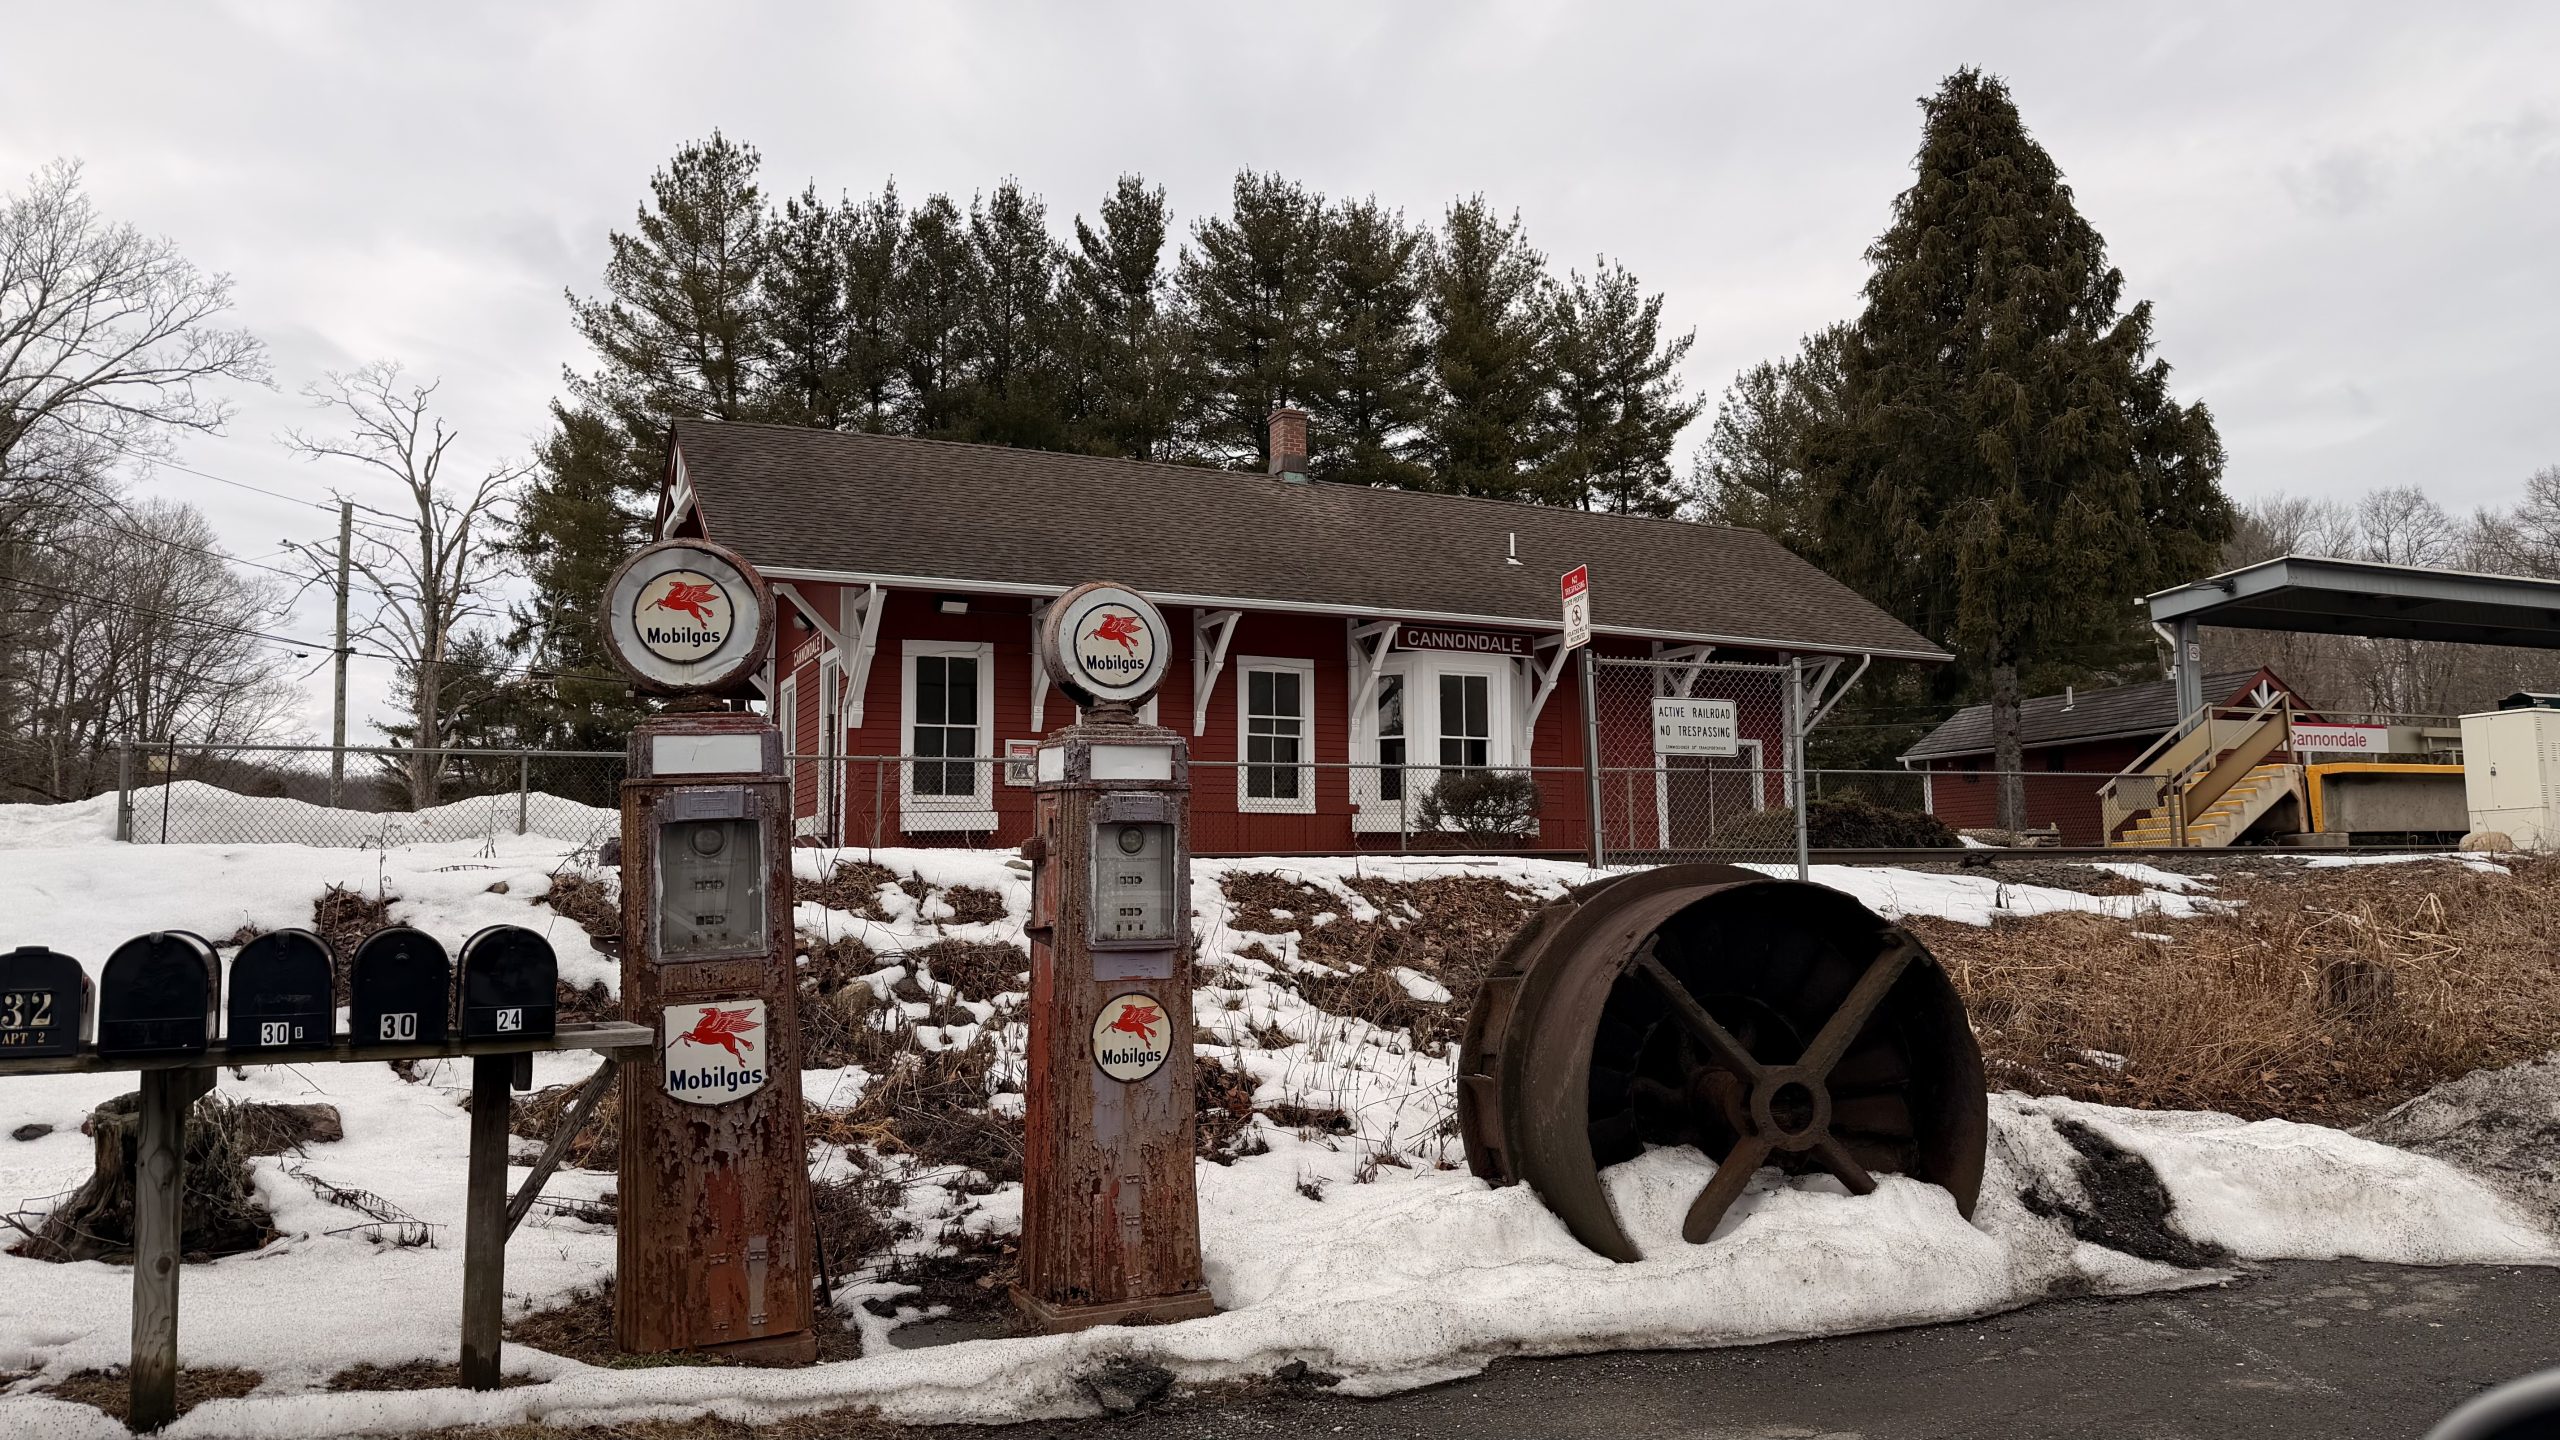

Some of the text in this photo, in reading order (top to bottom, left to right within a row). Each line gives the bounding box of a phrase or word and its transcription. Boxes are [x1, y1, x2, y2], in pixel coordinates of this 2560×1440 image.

[647, 626, 720, 647] Mobilgas
[1407, 630, 1522, 653] CANNONDALE
[793, 636, 820, 667] CANNONDALE
[1086, 655, 1144, 673] Mobilgas
[1658, 706, 1731, 719] ACTIVE RAILROAD
[1660, 725, 1731, 738] NO TRESPASSING
[0, 992, 52, 1030] 32
[498, 1010, 521, 1030] 24
[262, 1023, 287, 1044] 30
[382, 1014, 415, 1039] 30
[2, 1031, 46, 1045] APT 2
[1102, 1047, 1162, 1067] Mobilgas
[670, 1066, 763, 1092] Mobilgas
